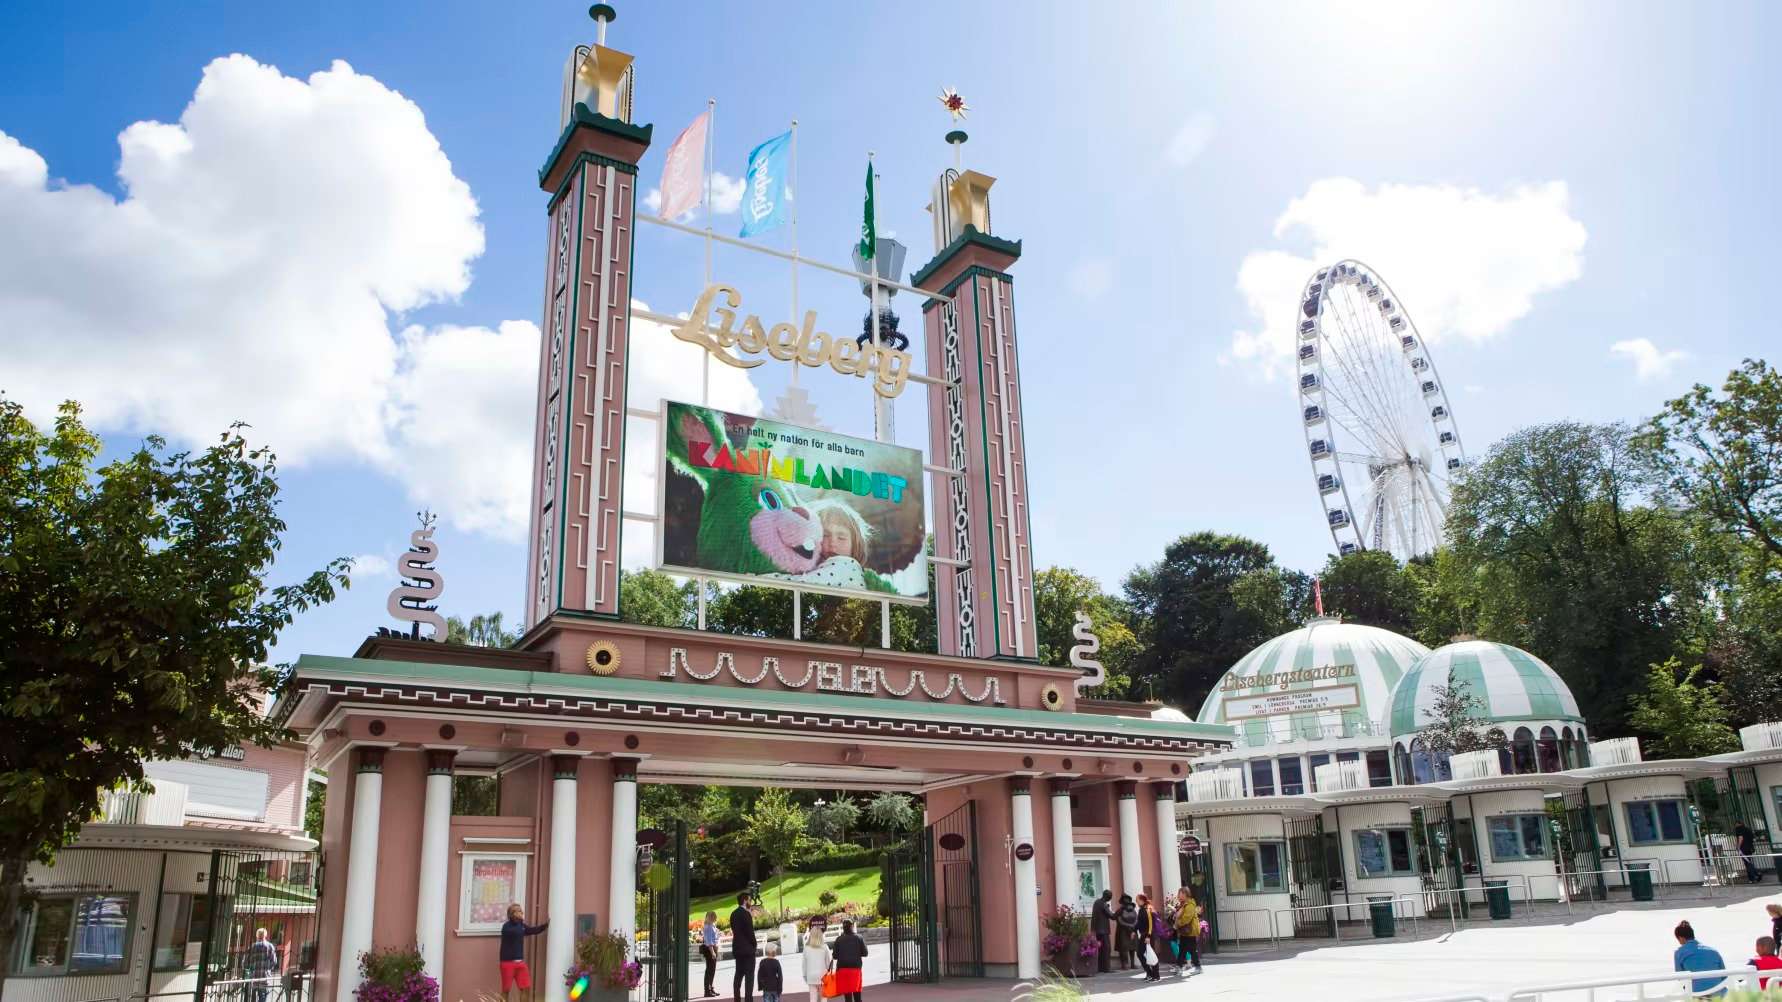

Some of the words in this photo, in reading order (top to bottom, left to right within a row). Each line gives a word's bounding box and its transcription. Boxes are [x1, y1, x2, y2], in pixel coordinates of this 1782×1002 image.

[670, 284, 912, 398] Liseberg
[732, 423, 744, 435] En
[747, 427, 764, 438] helt
[767, 431, 778, 441] ny
[780, 433, 809, 447] nation
[811, 438, 825, 449] för
[827, 442, 842, 453] alla
[845, 445, 865, 457] barn
[688, 440, 907, 503] KANINLANDET
[1220, 664, 1356, 692] Lisebergsteatern
